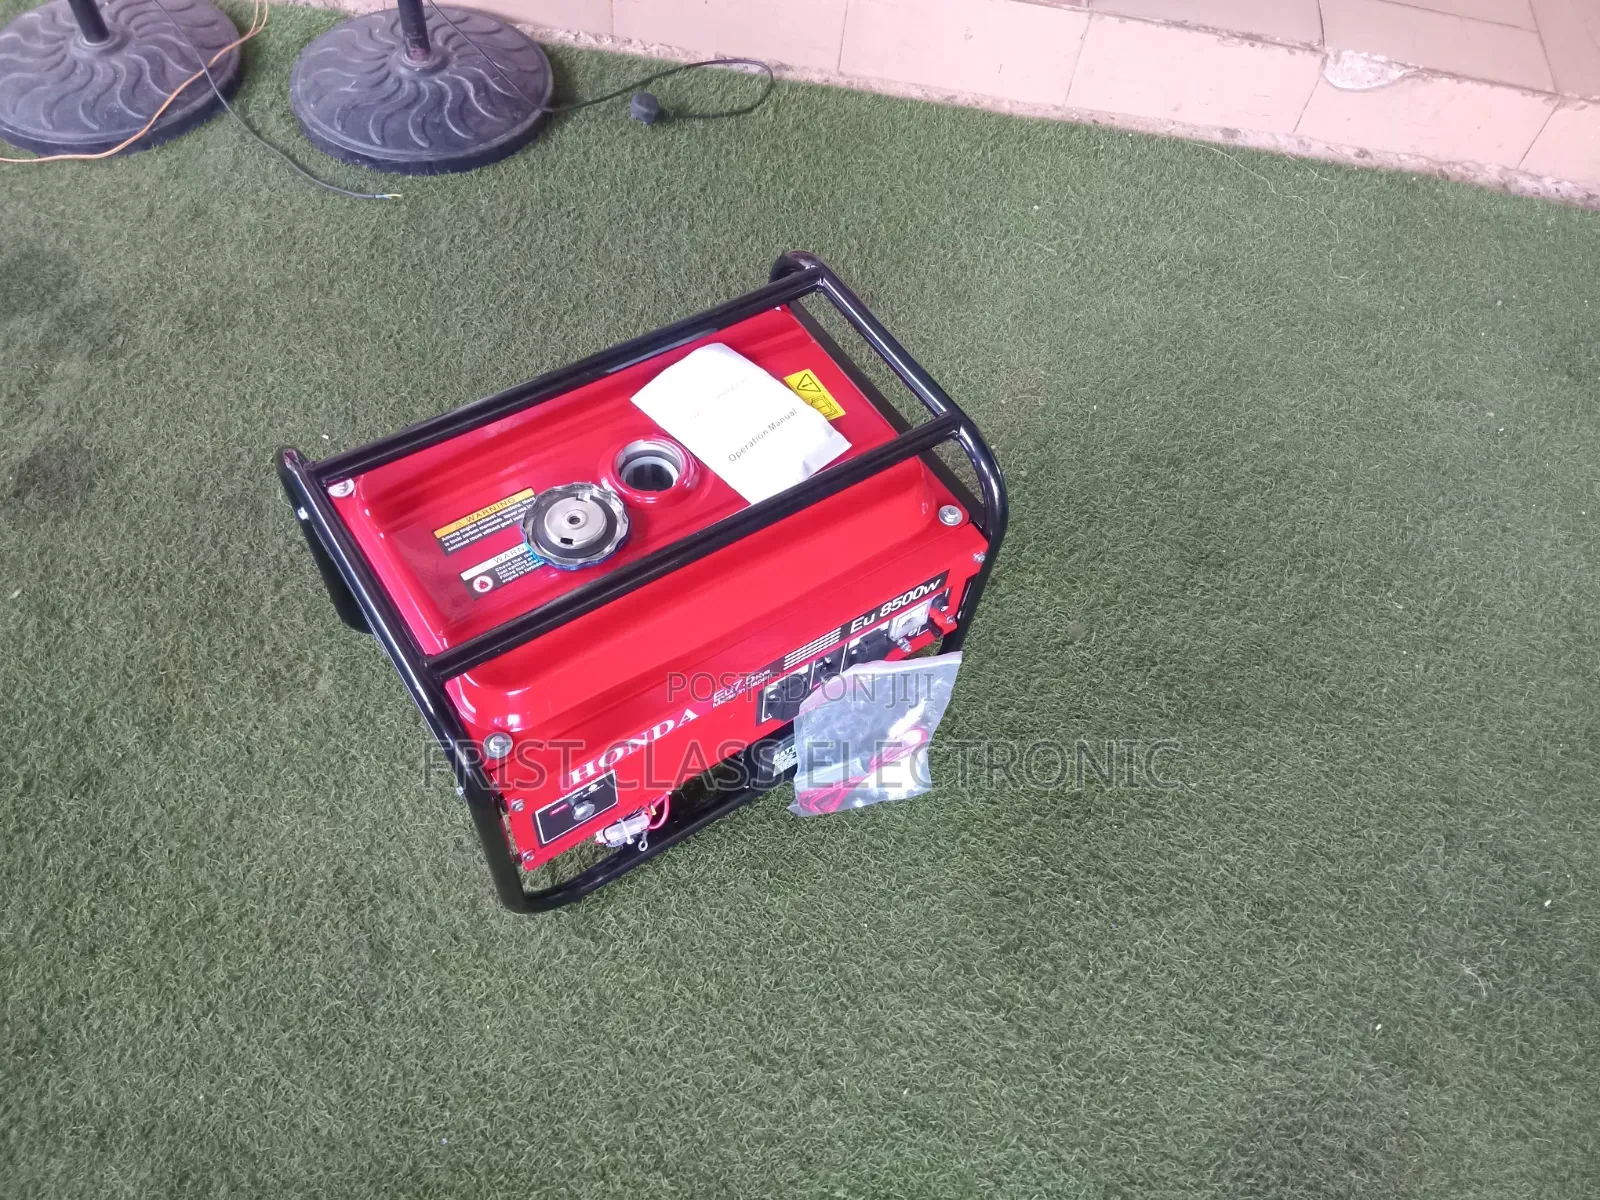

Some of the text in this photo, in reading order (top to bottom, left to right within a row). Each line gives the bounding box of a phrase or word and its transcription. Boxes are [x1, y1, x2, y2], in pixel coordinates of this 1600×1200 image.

[728, 407, 798, 463] Operation Manual
[466, 497, 516, 523] WARNING
[493, 547, 525, 564] WARN
[851, 616, 876, 634] Eu
[569, 708, 699, 786] HONDA
